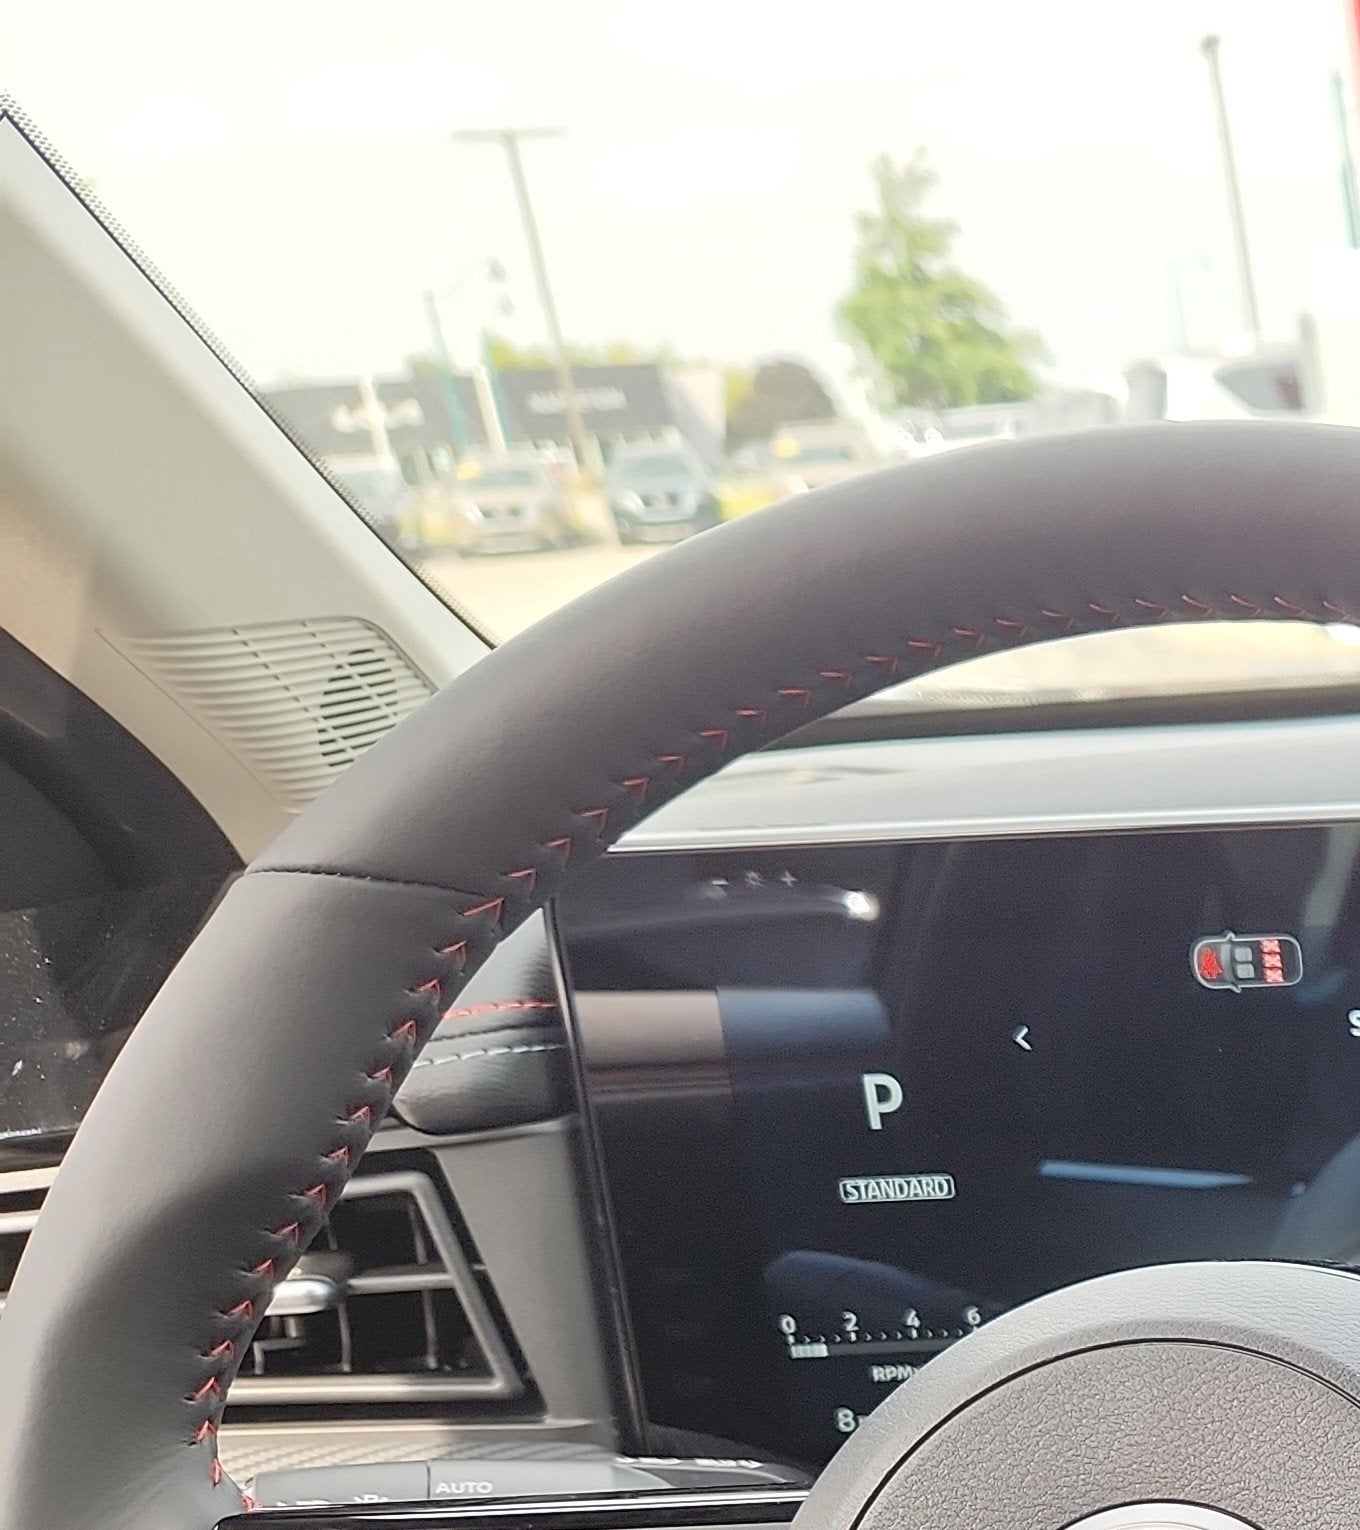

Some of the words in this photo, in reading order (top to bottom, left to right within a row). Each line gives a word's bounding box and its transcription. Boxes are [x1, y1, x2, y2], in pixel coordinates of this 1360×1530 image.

[862, 1073, 903, 1130] P
[845, 1178, 949, 1201] STANDARD
[781, 1314, 797, 1334] 0
[842, 1311, 859, 1331] 2
[903, 1307, 921, 1328] 4
[963, 1305, 982, 1326] 6
[435, 1481, 493, 1495] AUTO
